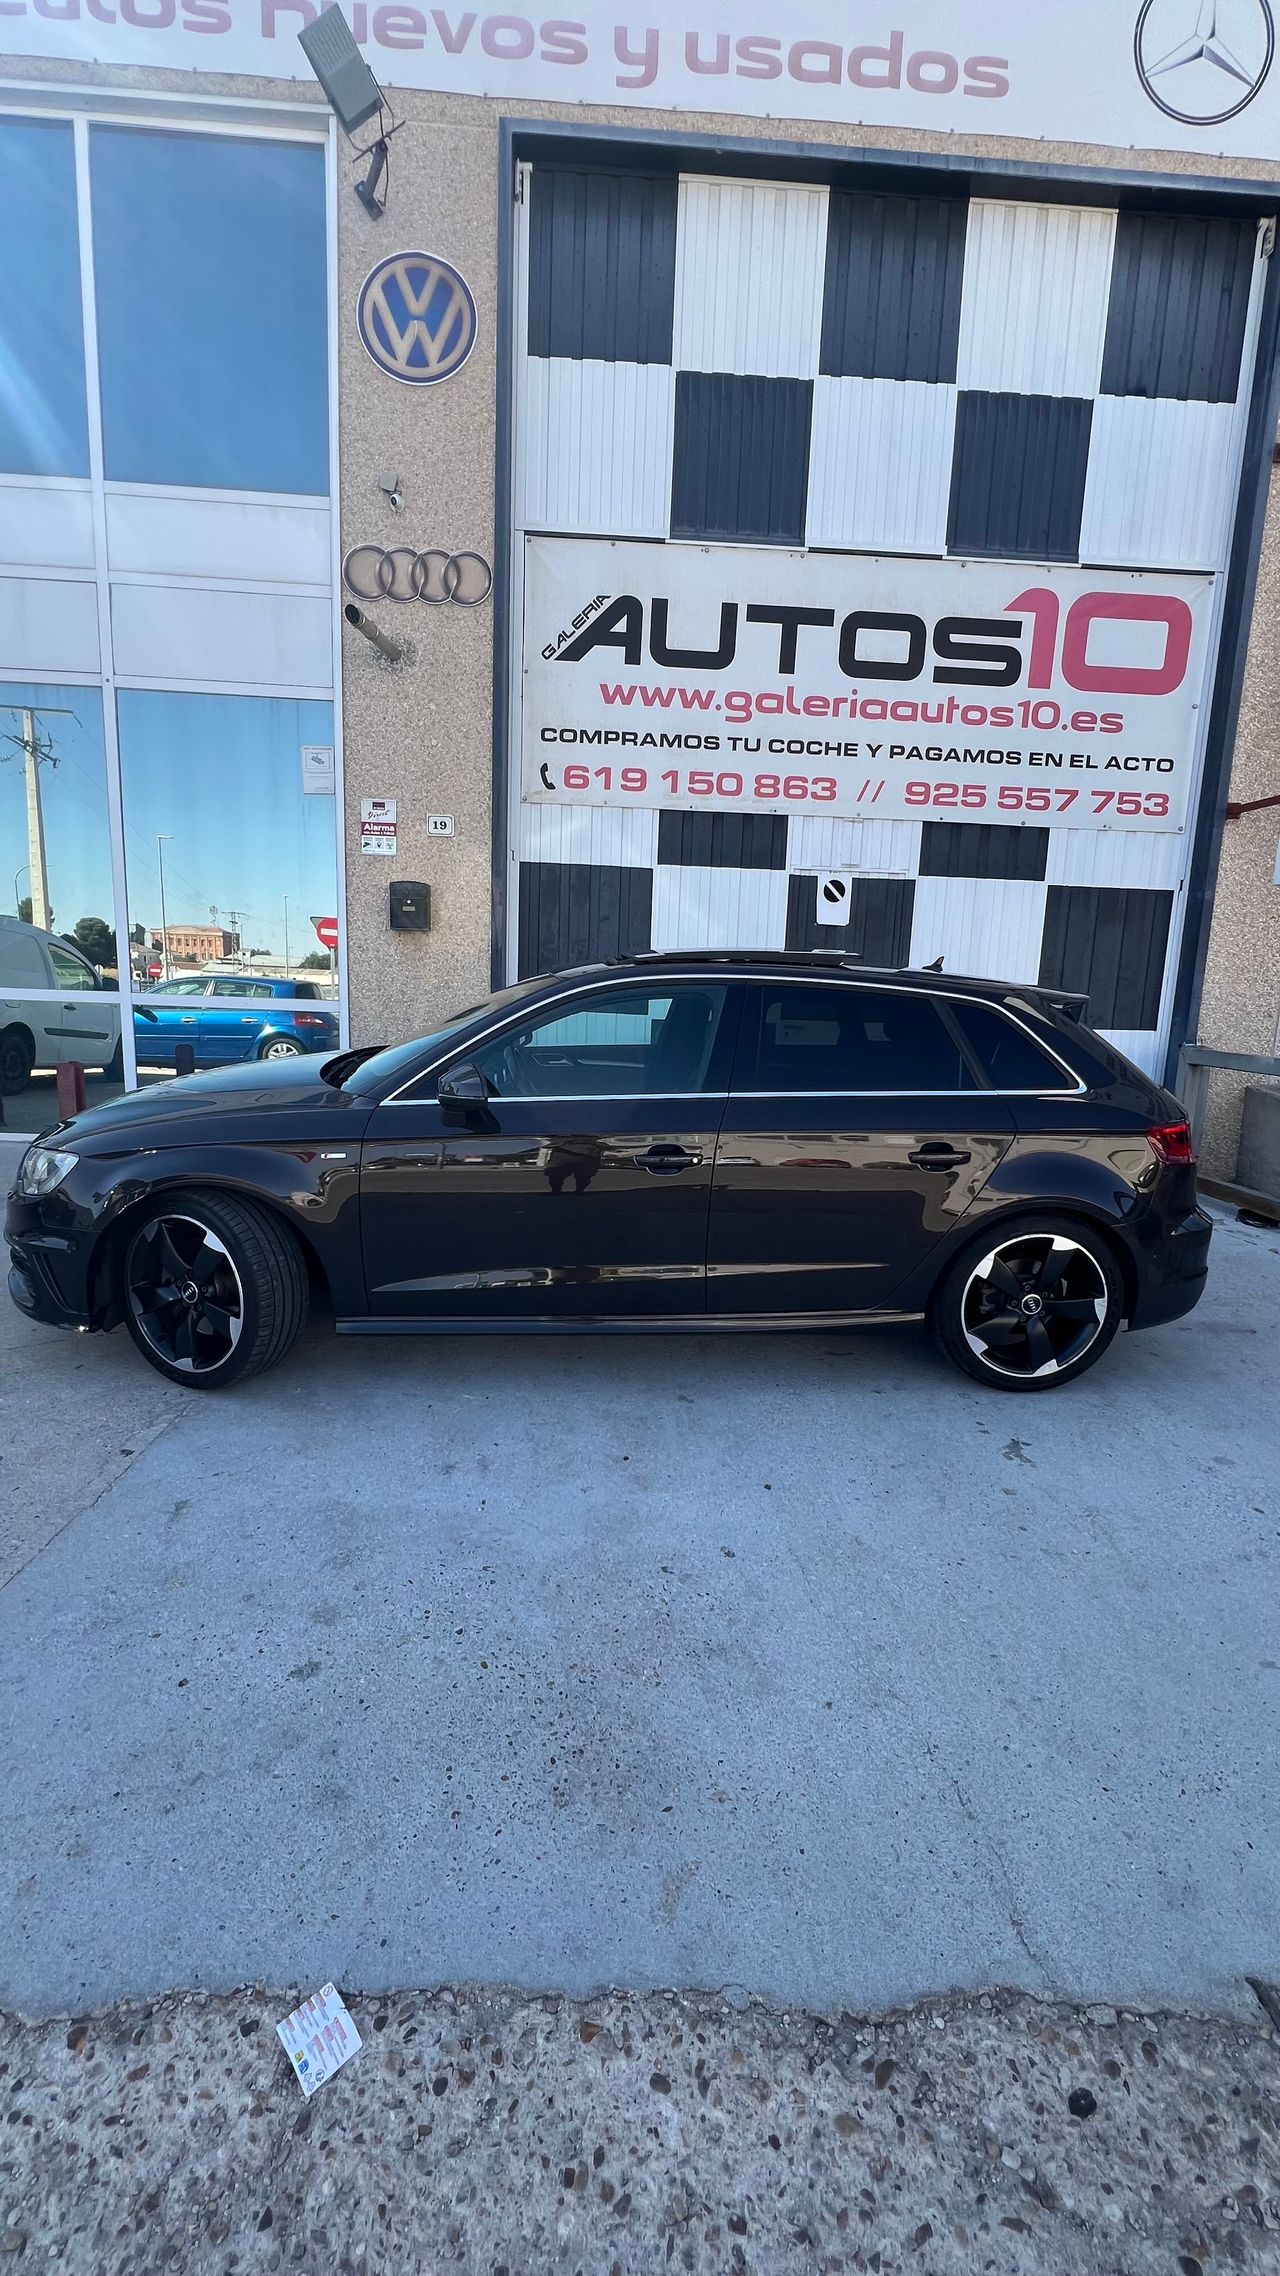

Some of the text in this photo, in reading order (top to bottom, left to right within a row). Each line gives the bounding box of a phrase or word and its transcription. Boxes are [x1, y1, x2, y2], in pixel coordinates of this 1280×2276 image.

[614, 25, 660, 88] y
[684, 30, 1010, 98] usados
[541, 594, 611, 661] GALERIA
[599, 683, 1124, 734] www.galeriaautos10.es
[540, 727, 1175, 773] COMPRAMOS TU COCHE Y PAGAMOS EN EL ACTO
[563, 764, 648, 792] 619
[661, 770, 744, 797] 150
[754, 774, 838, 801] 863
[904, 781, 988, 809] 925
[997, 786, 1080, 812] 557
[1091, 790, 1170, 817] 753
[363, 823, 395, 831] Alarma
[433, 820, 447, 830] 19
